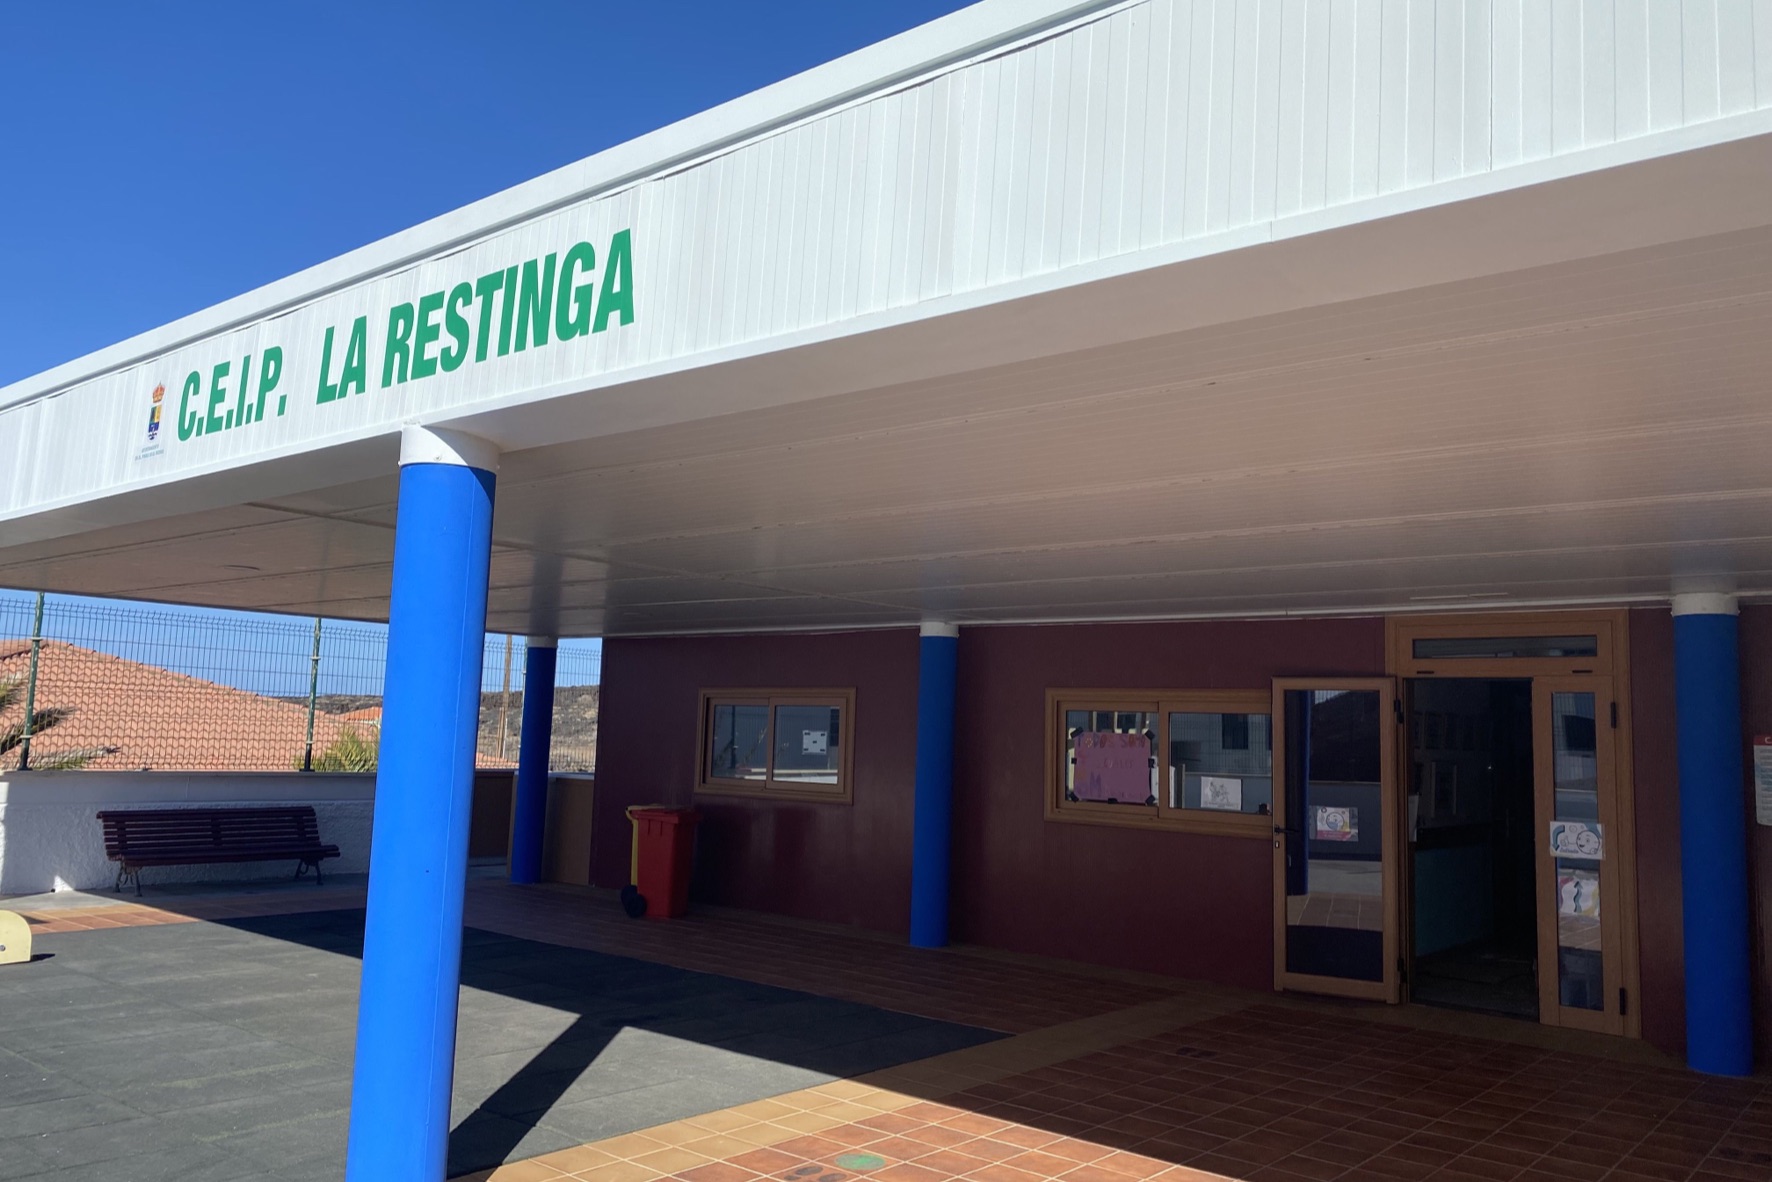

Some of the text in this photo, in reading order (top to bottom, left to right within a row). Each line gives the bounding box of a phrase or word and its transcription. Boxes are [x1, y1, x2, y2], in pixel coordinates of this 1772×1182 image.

[178, 228, 635, 442] C.E.I.P. LA RESTINGA
